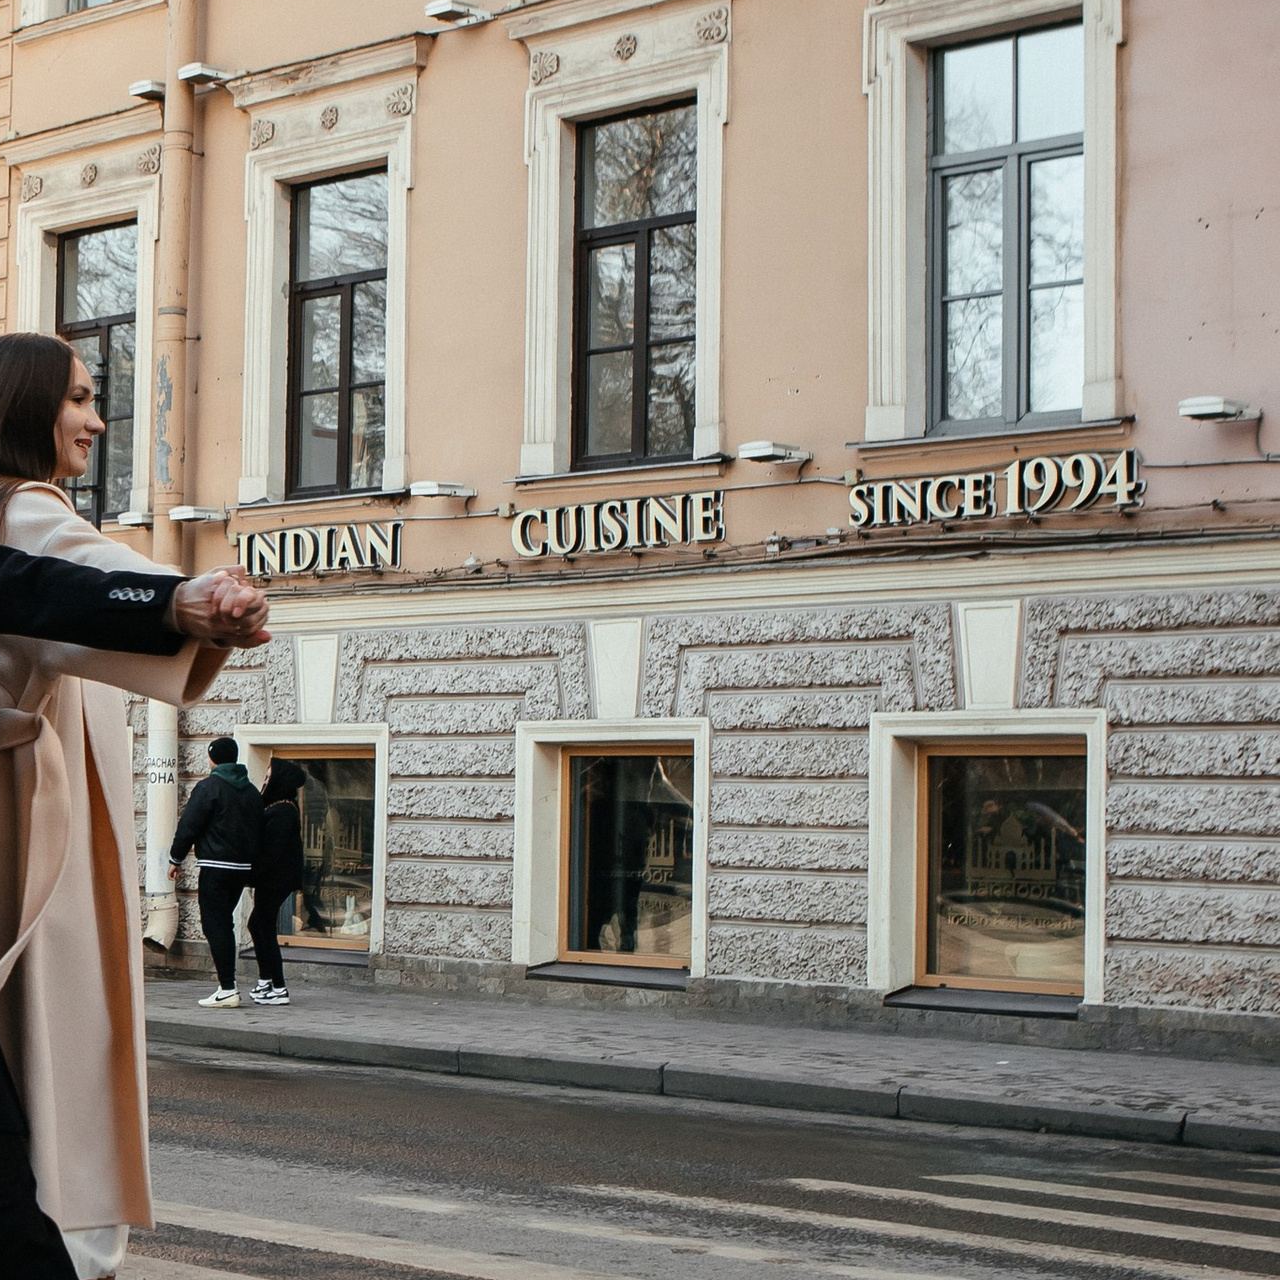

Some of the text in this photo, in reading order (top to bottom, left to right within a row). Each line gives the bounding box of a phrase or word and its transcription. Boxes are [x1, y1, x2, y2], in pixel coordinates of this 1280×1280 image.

[239, 449, 1145, 577] INDIAN CUISINE SINCE 1994
[146, 772, 175, 784] ОНА
